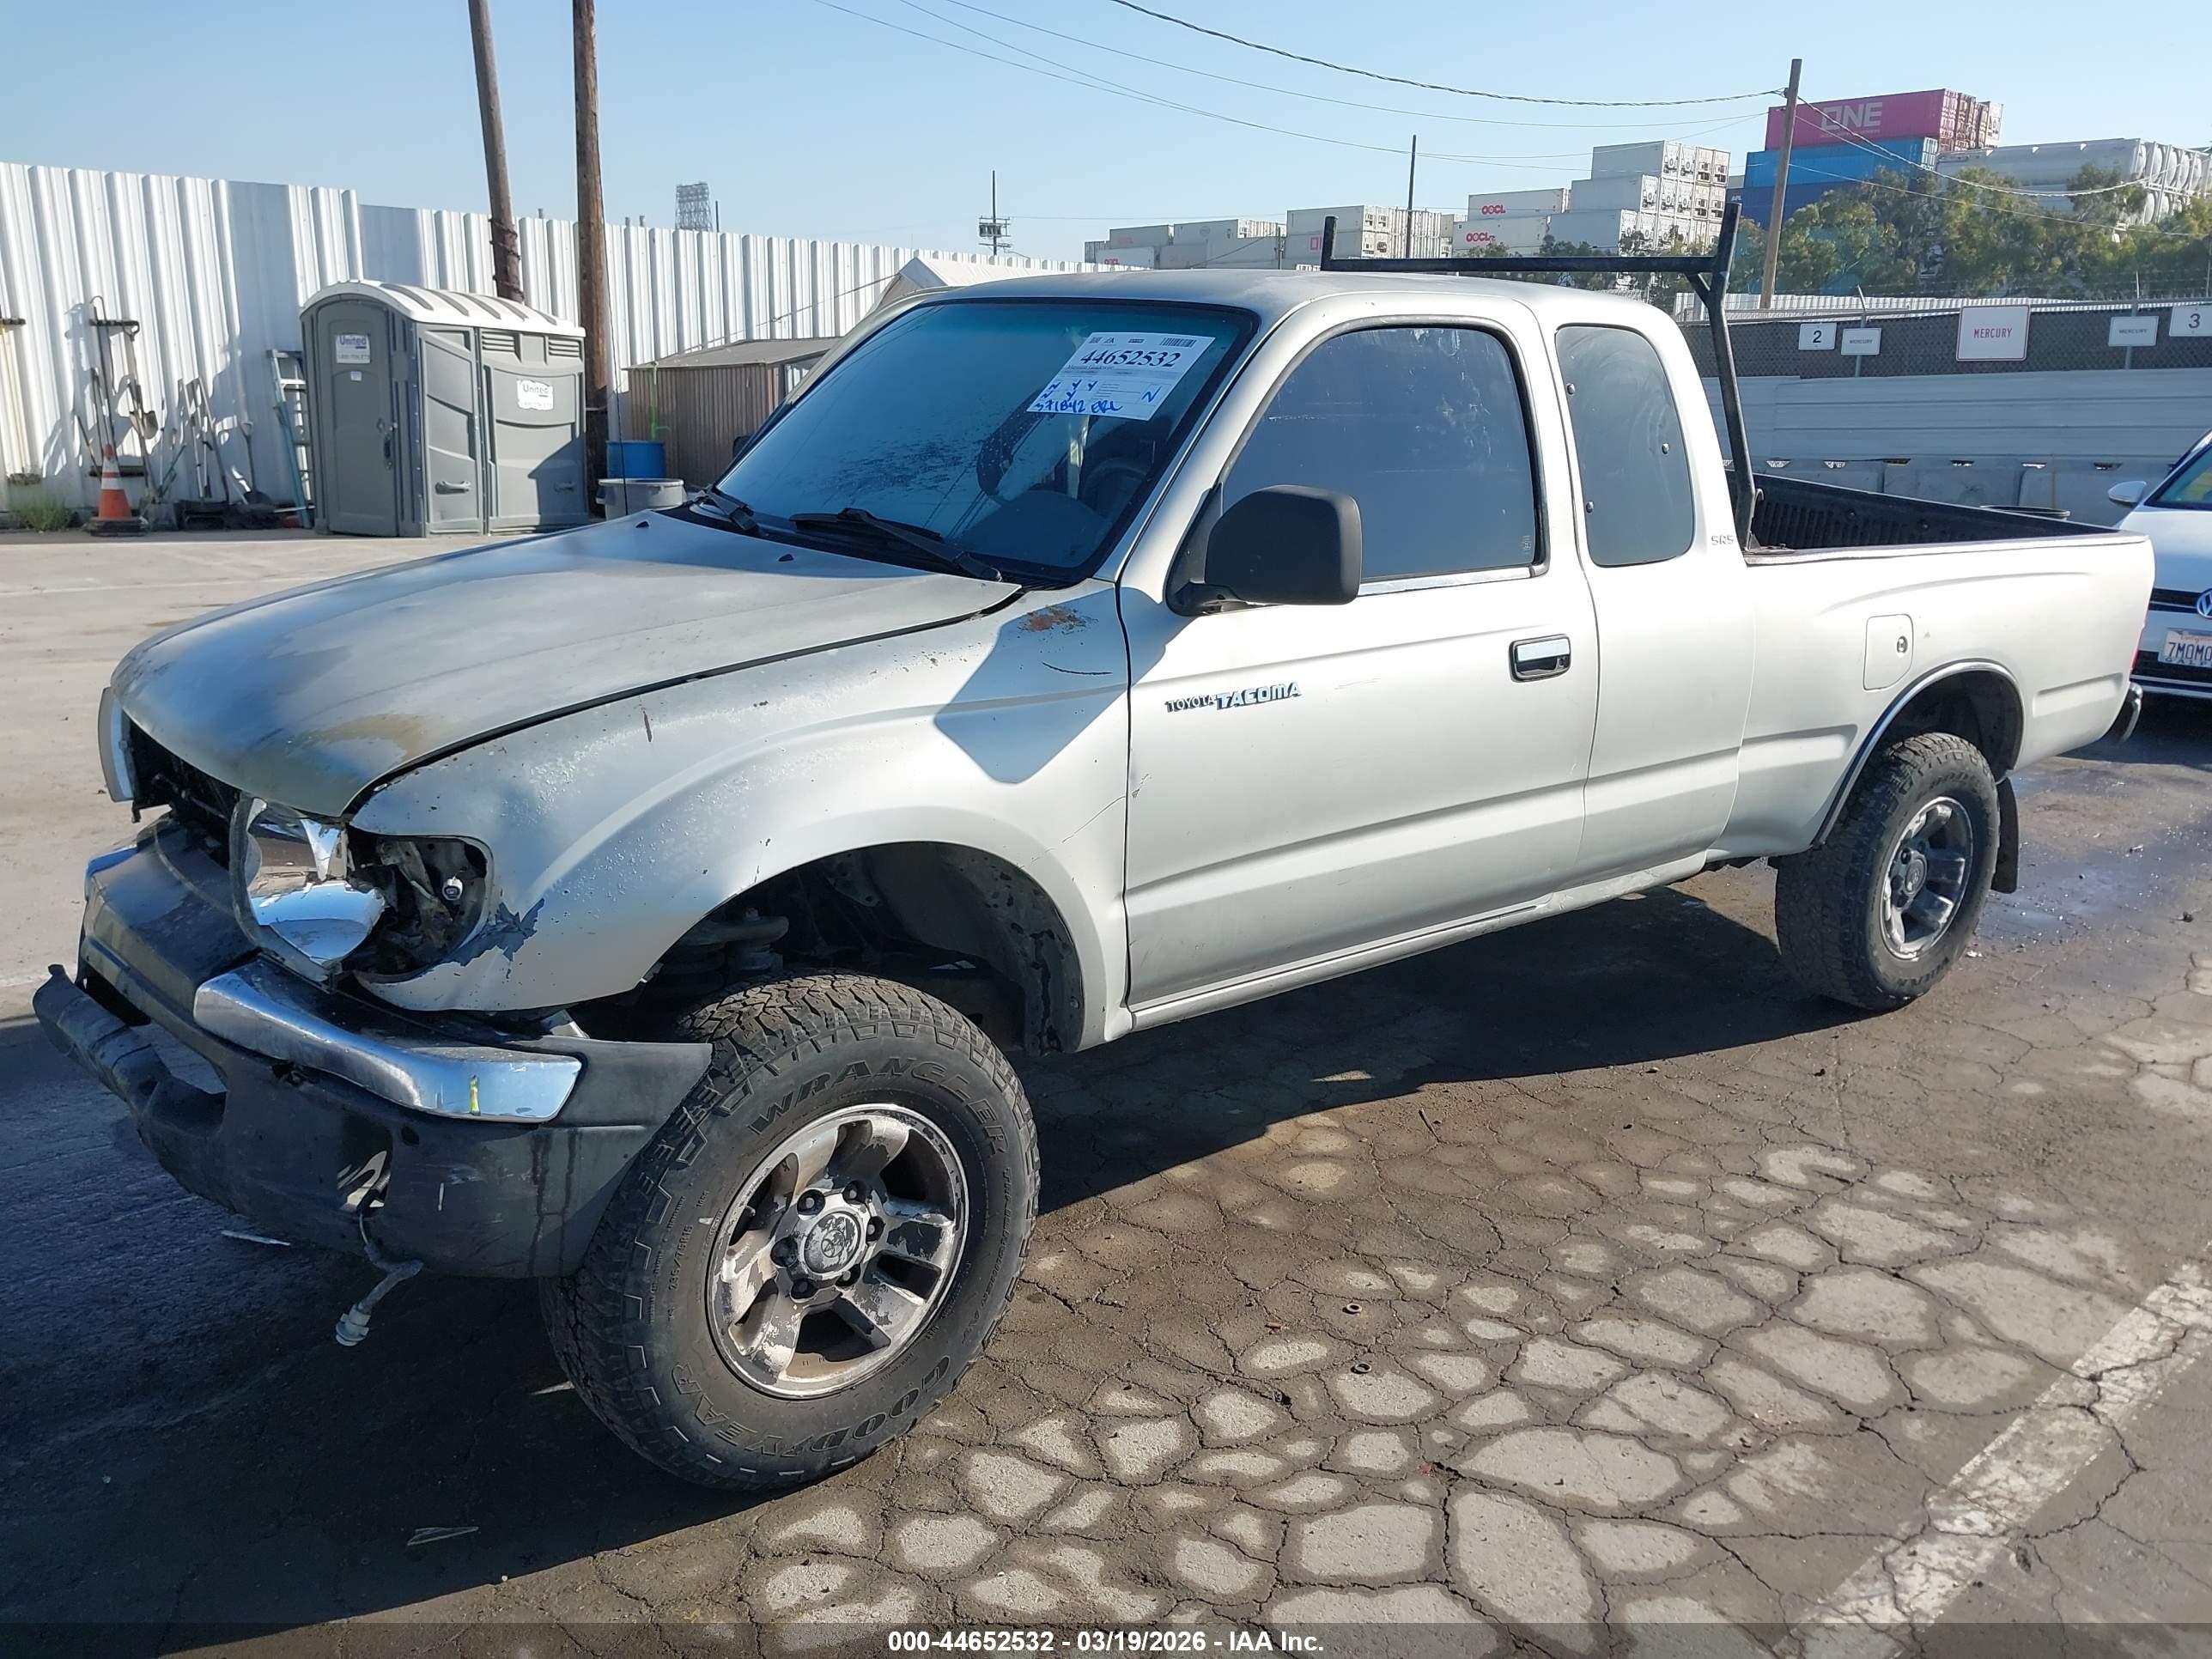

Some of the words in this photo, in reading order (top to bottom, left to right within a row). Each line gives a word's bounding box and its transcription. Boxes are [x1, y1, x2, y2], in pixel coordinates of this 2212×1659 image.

[1820, 101, 1883, 131] ONE
[1481, 204, 1506, 215] OOCL
[1466, 232, 1491, 242] OOCL
[2188, 313, 2201, 329] 3
[1812, 330, 1822, 343] 2
[1973, 328, 2013, 338] MERCURY
[1080, 349, 1182, 368] 44652532
[1164, 695, 1217, 713] TOYOTA
[1216, 681, 1303, 710] TACOMA
[746, 1055, 1010, 1156] WRANGLER
[672, 1355, 951, 1458] GOODYEAR
